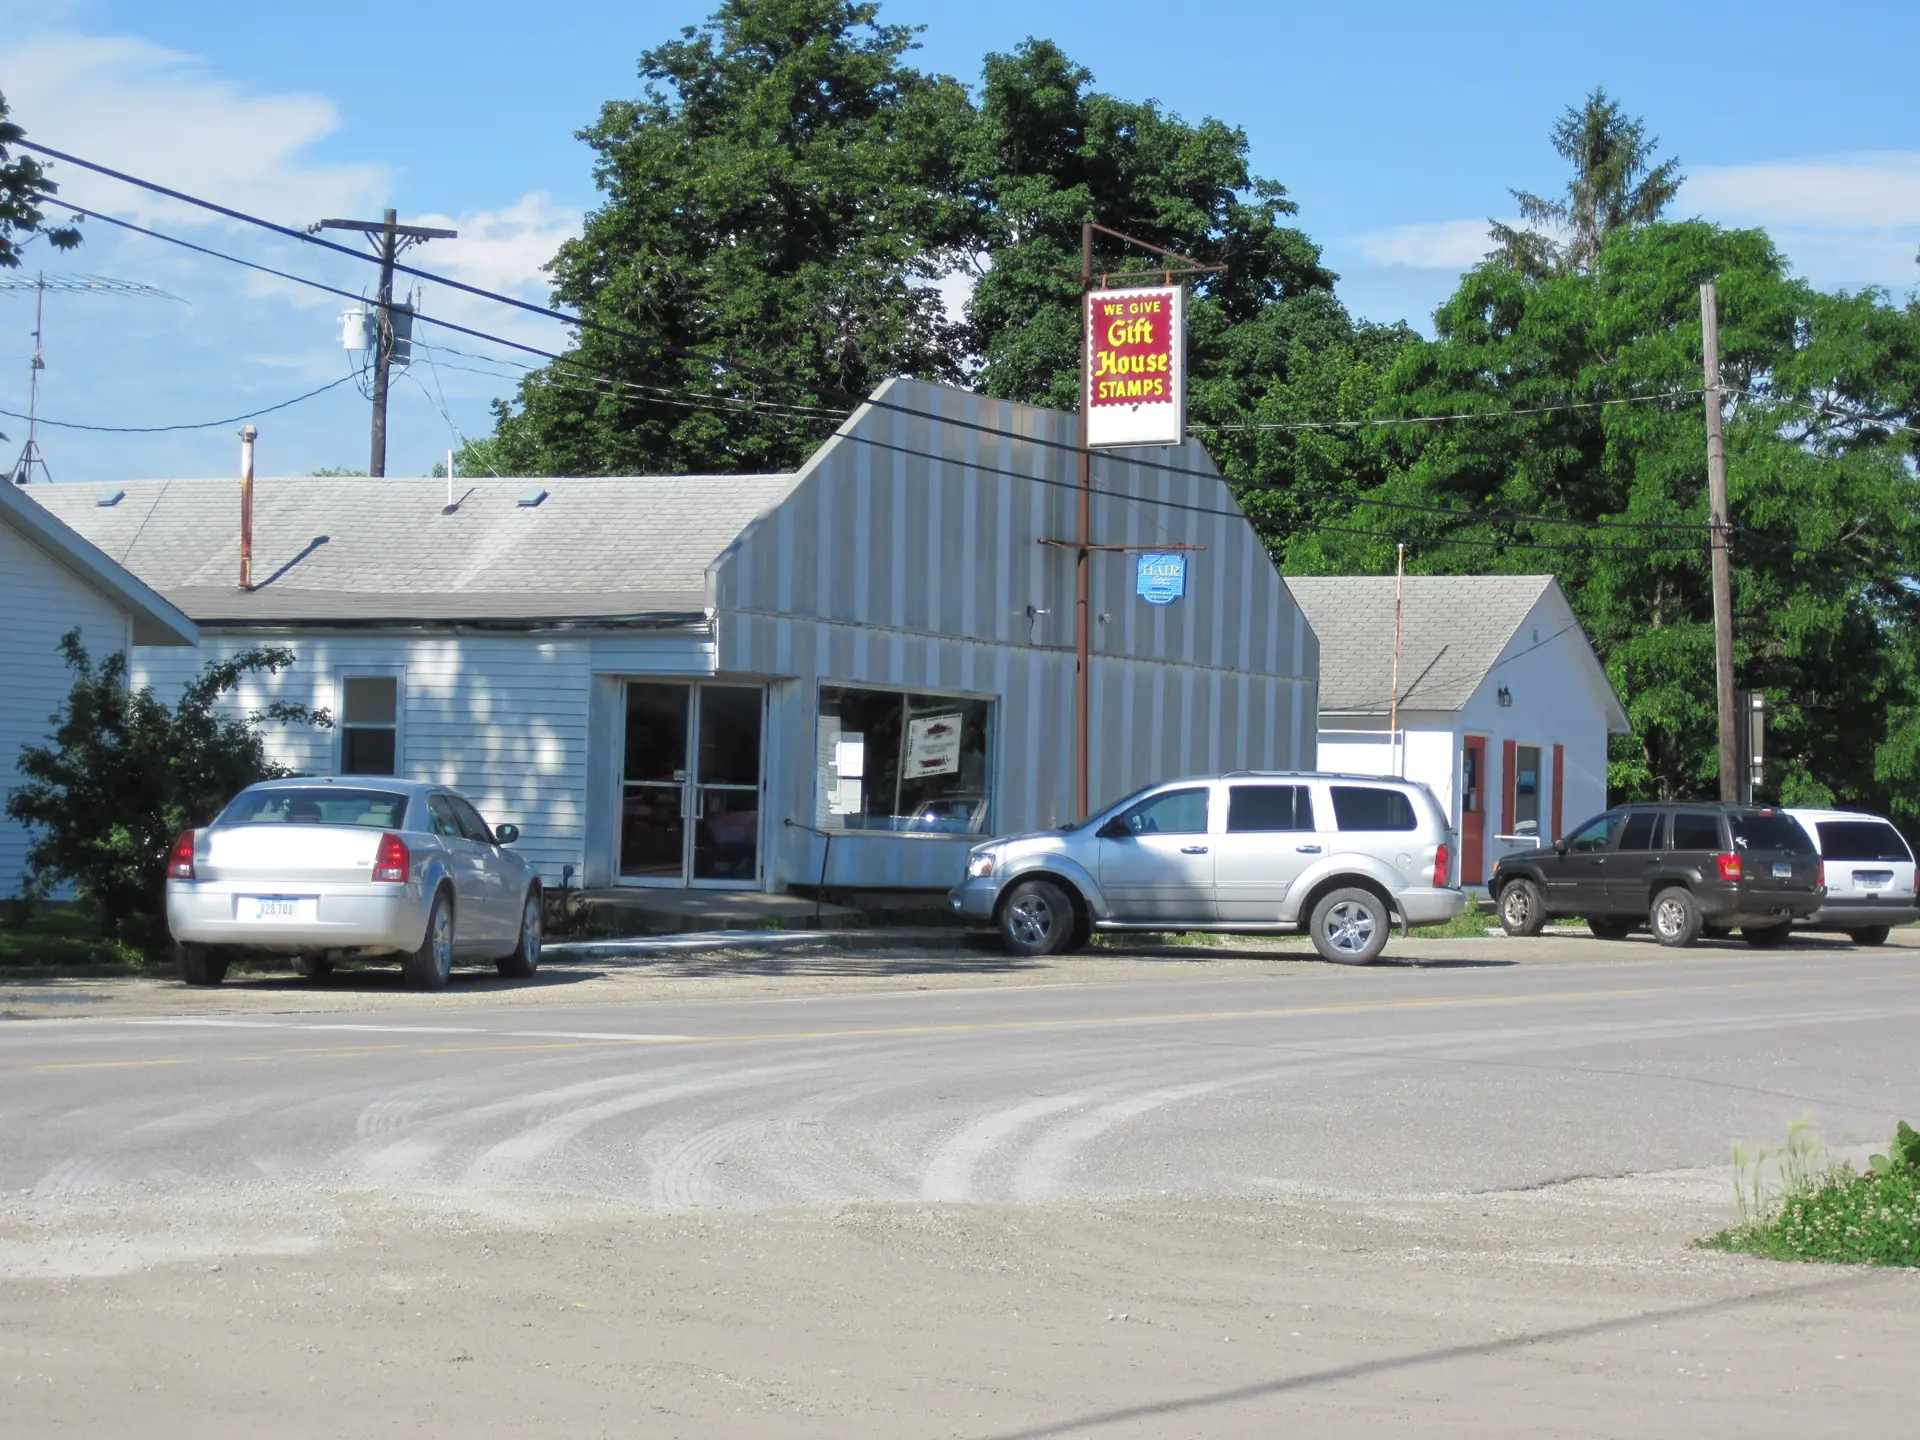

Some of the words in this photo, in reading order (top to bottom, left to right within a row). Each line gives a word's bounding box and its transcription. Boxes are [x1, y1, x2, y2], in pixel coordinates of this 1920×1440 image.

[1104, 304, 1123, 316] WE
[1129, 301, 1161, 314] GIVE
[1108, 317, 1154, 347] Gift
[1094, 351, 1168, 376] House
[1099, 378, 1163, 399] STAMPS
[1142, 564, 1180, 576] HAIR
